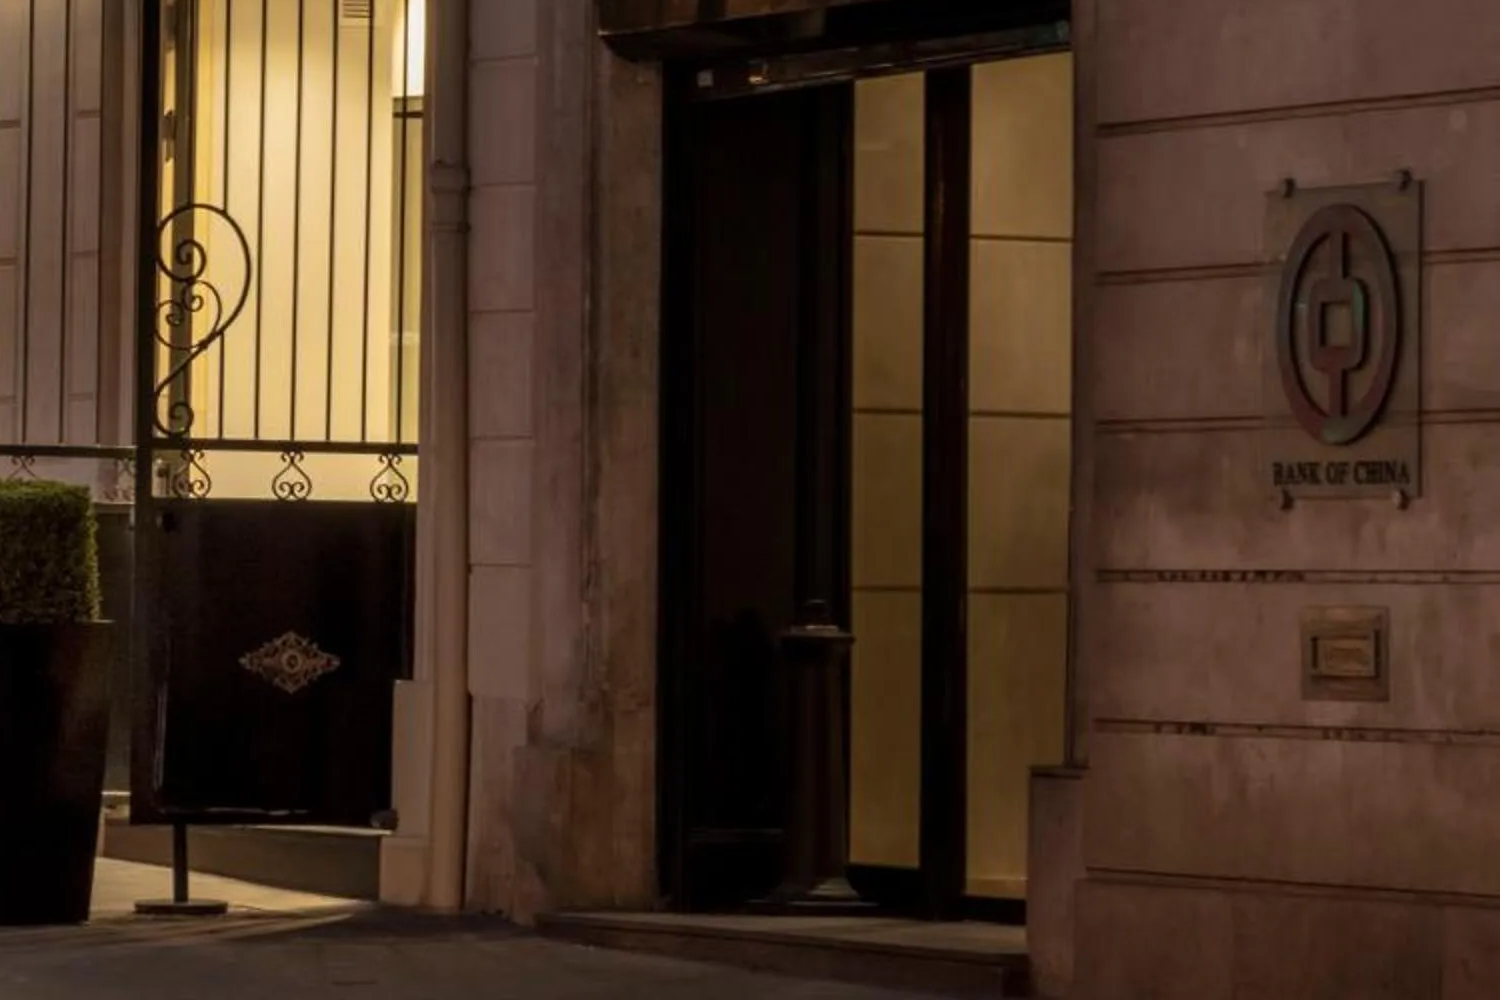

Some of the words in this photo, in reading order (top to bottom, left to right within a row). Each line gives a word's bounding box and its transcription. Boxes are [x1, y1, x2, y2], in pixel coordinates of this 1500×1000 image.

[1272, 461, 1322, 486] BANK
[1325, 460, 1349, 486] OF
[1353, 459, 1411, 485] CHINA
